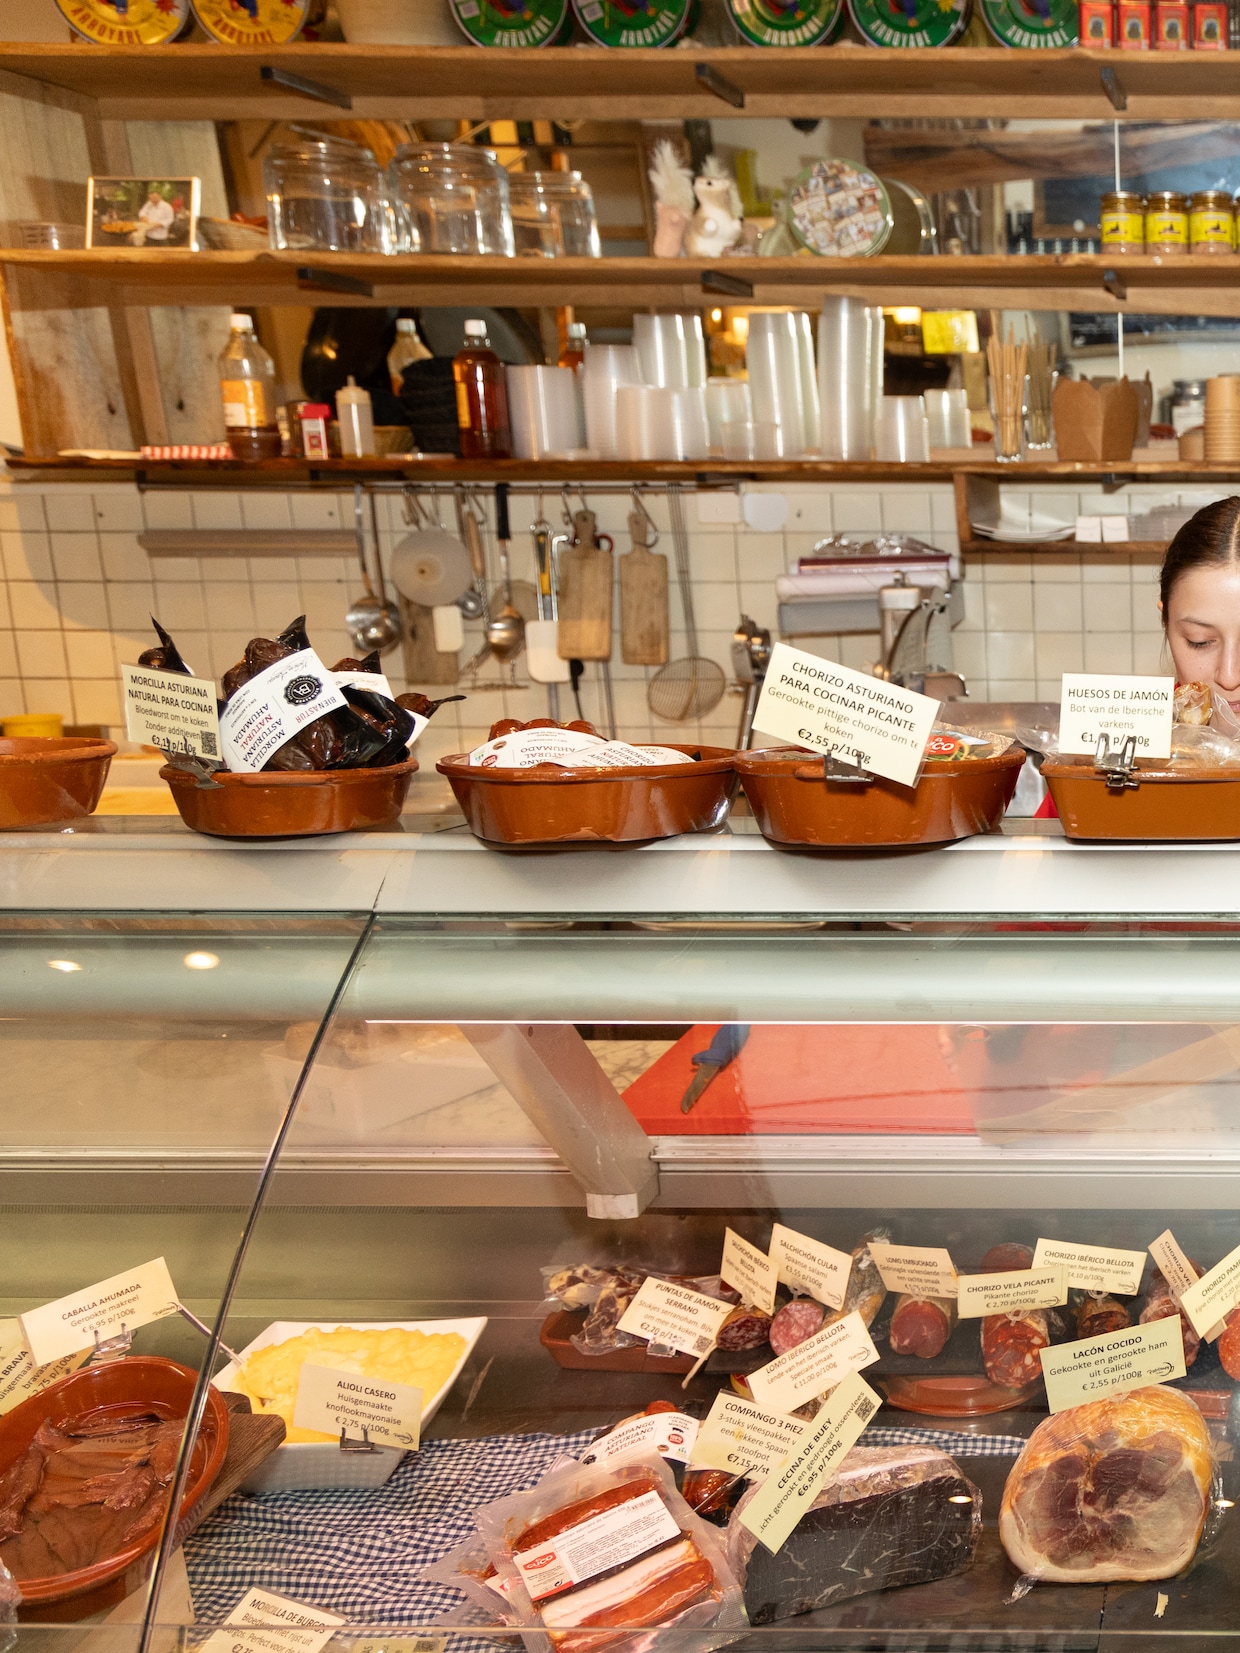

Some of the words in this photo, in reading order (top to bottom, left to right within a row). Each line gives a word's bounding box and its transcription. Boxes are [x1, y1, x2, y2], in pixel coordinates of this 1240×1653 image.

[130, 675, 166, 689] MORCILLA
[167, 683, 208, 698] ASTURIANA
[792, 662, 844, 688] CHORIZO
[846, 682, 913, 714] ASTURIANO
[1068, 688, 1110, 698] HUESOS
[1113, 690, 1126, 699] DE
[1129, 690, 1168, 700] JAMÓN
[128, 689, 160, 704] NATURAL
[162, 696, 180, 707] PARA
[181, 700, 213, 714] COCINAR
[295, 696, 337, 723] BIENASTUR
[780, 674, 809, 693] PARA
[814, 687, 864, 713] COCINAR
[868, 707, 916, 732] PICANTE
[1070, 704, 1086, 712] Bot
[1108, 705, 1120, 714] de
[1122, 706, 1164, 716] Iberische
[135, 705, 169, 719] Bloedworst
[190, 717, 209, 727] koken
[233, 703, 269, 744] AHUMADA
[1099, 721, 1134, 729] varkens
[145, 721, 167, 732] Zonder
[168, 727, 200, 740] additieven
[240, 714, 273, 750] NATURAL
[242, 718, 283, 762] ASTURIANA
[824, 722, 854, 740] koken
[251, 729, 286, 768] MORCILLA
[798, 728, 829, 747] €2,55
[831, 743, 871, 764] p/100g
[780, 1240, 816, 1262] SALCHICHÓN
[817, 1259, 838, 1272] CULAR
[1045, 1251, 1076, 1260] CHORIZO
[1078, 1255, 1105, 1264] IBÉRICO
[1106, 1259, 1134, 1267] BELLOTA
[967, 1285, 1001, 1293] CHORIZO
[1024, 1278, 1055, 1287] PICANTE
[984, 1292, 1010, 1300] Pikante
[1012, 1289, 1038, 1297] chorizo
[1201, 1272, 1226, 1297] CHORIZO
[62, 1302, 98, 1320] CABALLA
[100, 1283, 142, 1306] AHUMADA
[656, 1284, 683, 1297] PUNTAS
[683, 1293, 694, 1301] DE
[694, 1297, 721, 1312] JAMÓN
[665, 1298, 698, 1315] SERRANO
[71, 1309, 107, 1327] Gerookte
[108, 1295, 139, 1311] makreel
[766, 1357, 787, 1374] LOMO
[788, 1341, 815, 1361] IBÉRICO
[816, 1324, 846, 1343] BELLOTA
[1050, 1362, 1092, 1376] Gekookte
[1095, 1358, 1105, 1366] en
[1108, 1346, 1146, 1363] gerookte
[1148, 1341, 1168, 1351] ham
[1073, 1347, 1104, 1359] LACÓN
[1107, 1336, 1142, 1351] COCIDO
[337, 1381, 362, 1393] ALIOLI
[365, 1388, 396, 1400] CASERO
[338, 1393, 392, 1412] Huisgemaakte
[326, 1402, 402, 1426] knoflookmayonaise
[725, 1402, 776, 1425] COMPANGO
[777, 1420, 784, 1428] 3
[605, 1427, 654, 1452] ASTURIANO
[607, 1421, 655, 1445] COMPANGO
[608, 1436, 646, 1456] NATURAL
[777, 1456, 803, 1489] CECINA
[804, 1443, 815, 1456] DE
[814, 1417, 833, 1442] BUEY
[527, 1555, 553, 1569] CUCO
[250, 1599, 286, 1618] MORCILLA
[286, 1612, 298, 1622] DE
